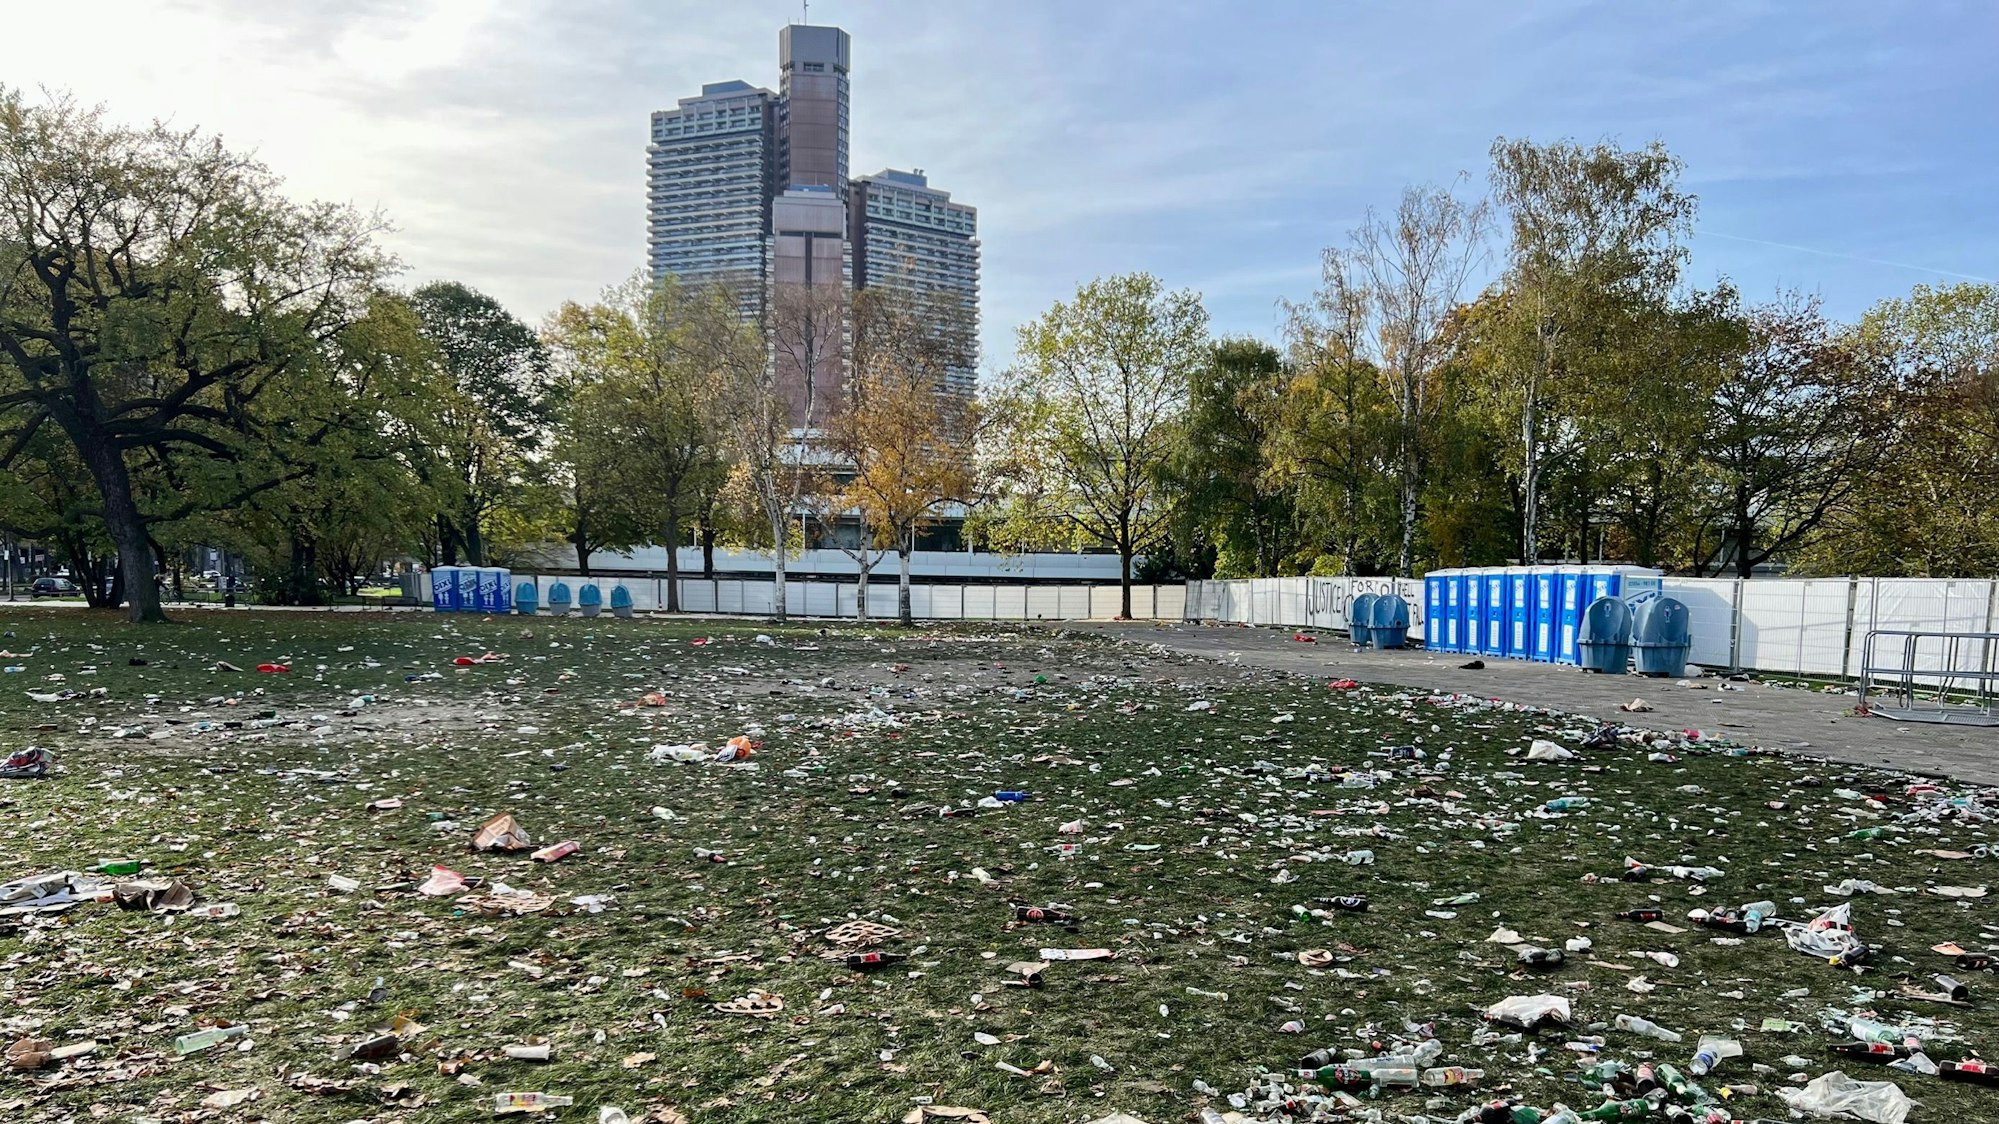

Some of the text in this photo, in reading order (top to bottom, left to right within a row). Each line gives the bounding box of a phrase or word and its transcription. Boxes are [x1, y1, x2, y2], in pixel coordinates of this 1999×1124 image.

[433, 579, 452, 591] DIXI
[1308, 580, 1341, 616] JUSTICE
[1352, 580, 1374, 592] FOR
